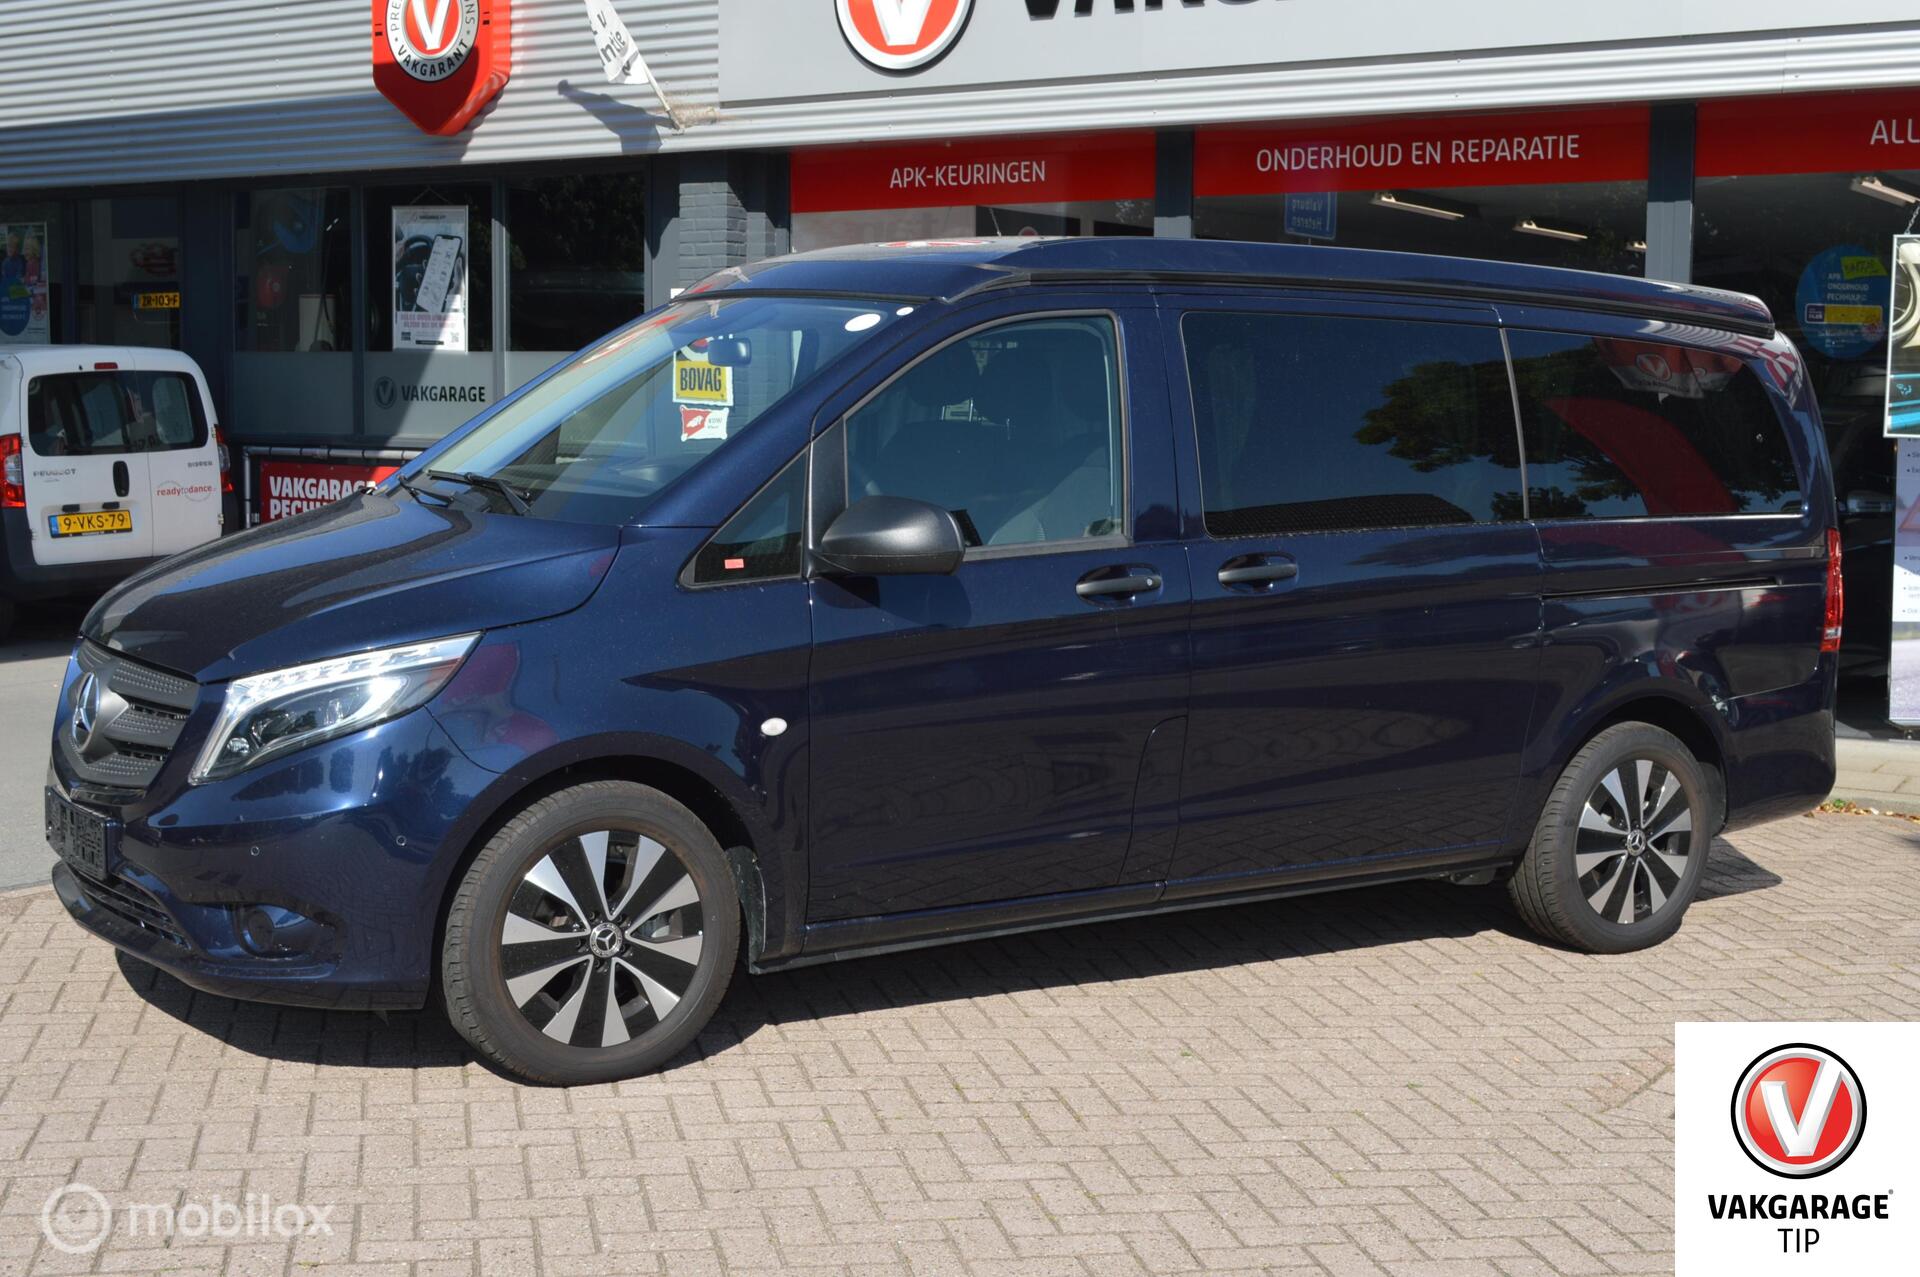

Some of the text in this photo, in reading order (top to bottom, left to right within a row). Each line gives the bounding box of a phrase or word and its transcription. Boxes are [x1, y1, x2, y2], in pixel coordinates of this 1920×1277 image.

[397, 39, 468, 77] VAKGARANT
[1870, 118, 1920, 145] ALL
[1256, 135, 1580, 172] ONDERHOUD EN REPARATIE
[889, 161, 1046, 189] APK-KEURINGEN
[680, 367, 722, 391] BOVAG
[401, 385, 486, 402] VAKGARAGE
[63, 513, 125, 531] 9-VKS-79
